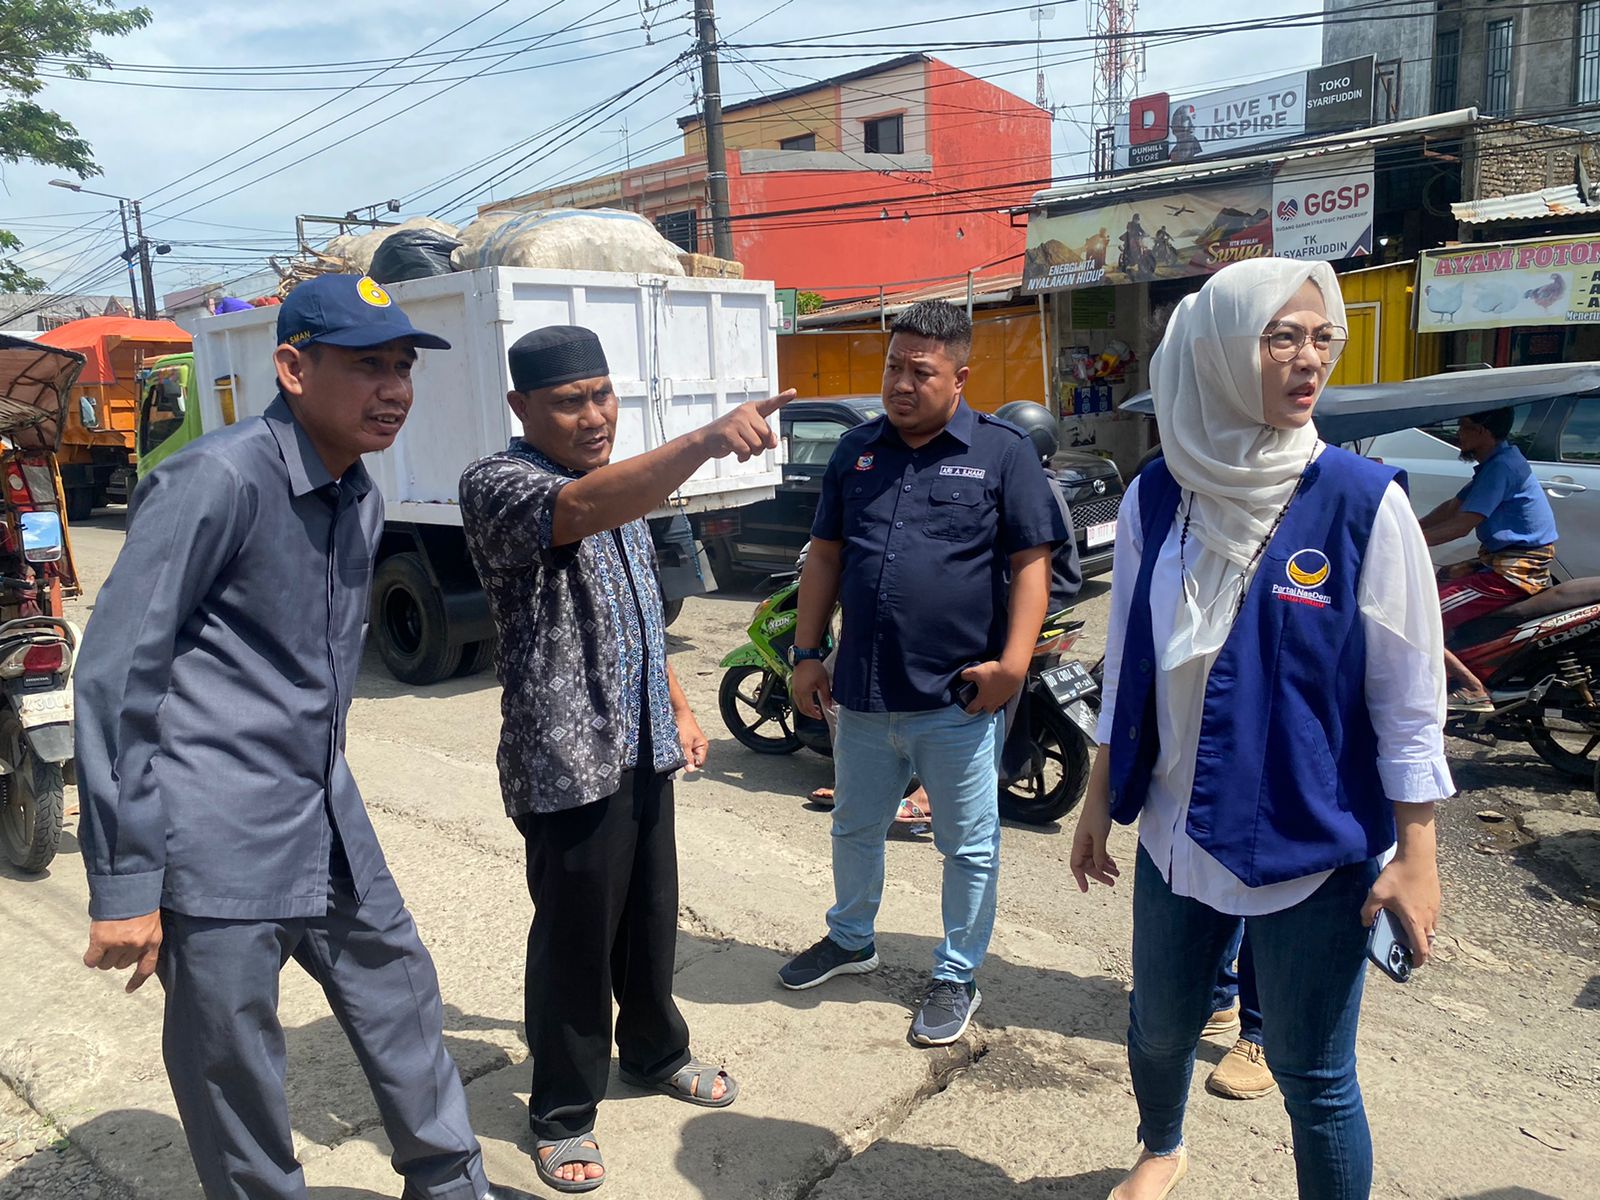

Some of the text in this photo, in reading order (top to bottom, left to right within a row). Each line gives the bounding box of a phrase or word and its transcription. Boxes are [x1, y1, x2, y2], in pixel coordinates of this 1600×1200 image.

[1320, 77, 1350, 92] TOKO
[1213, 90, 1297, 124] LIVE TO
[1307, 89, 1363, 109] SYARIFUDDIN
[1204, 111, 1288, 141] INSPIRE
[1131, 145, 1163, 156] DUNHILL
[1135, 154, 1159, 163] STORE
[1304, 183, 1369, 216] GGSP
[1311, 218, 1336, 226] STRATEGIC
[1336, 211, 1368, 221] PARTNERSHIP
[1304, 234, 1317, 245] TK
[1284, 241, 1348, 258] SYAFRUDDIN
[1049, 262, 1078, 276] ENERGI
[1434, 247, 1514, 276] AYAM
[1027, 268, 1105, 290] NYALAKAN HIDUP
[1272, 584, 1297, 596] Partai
